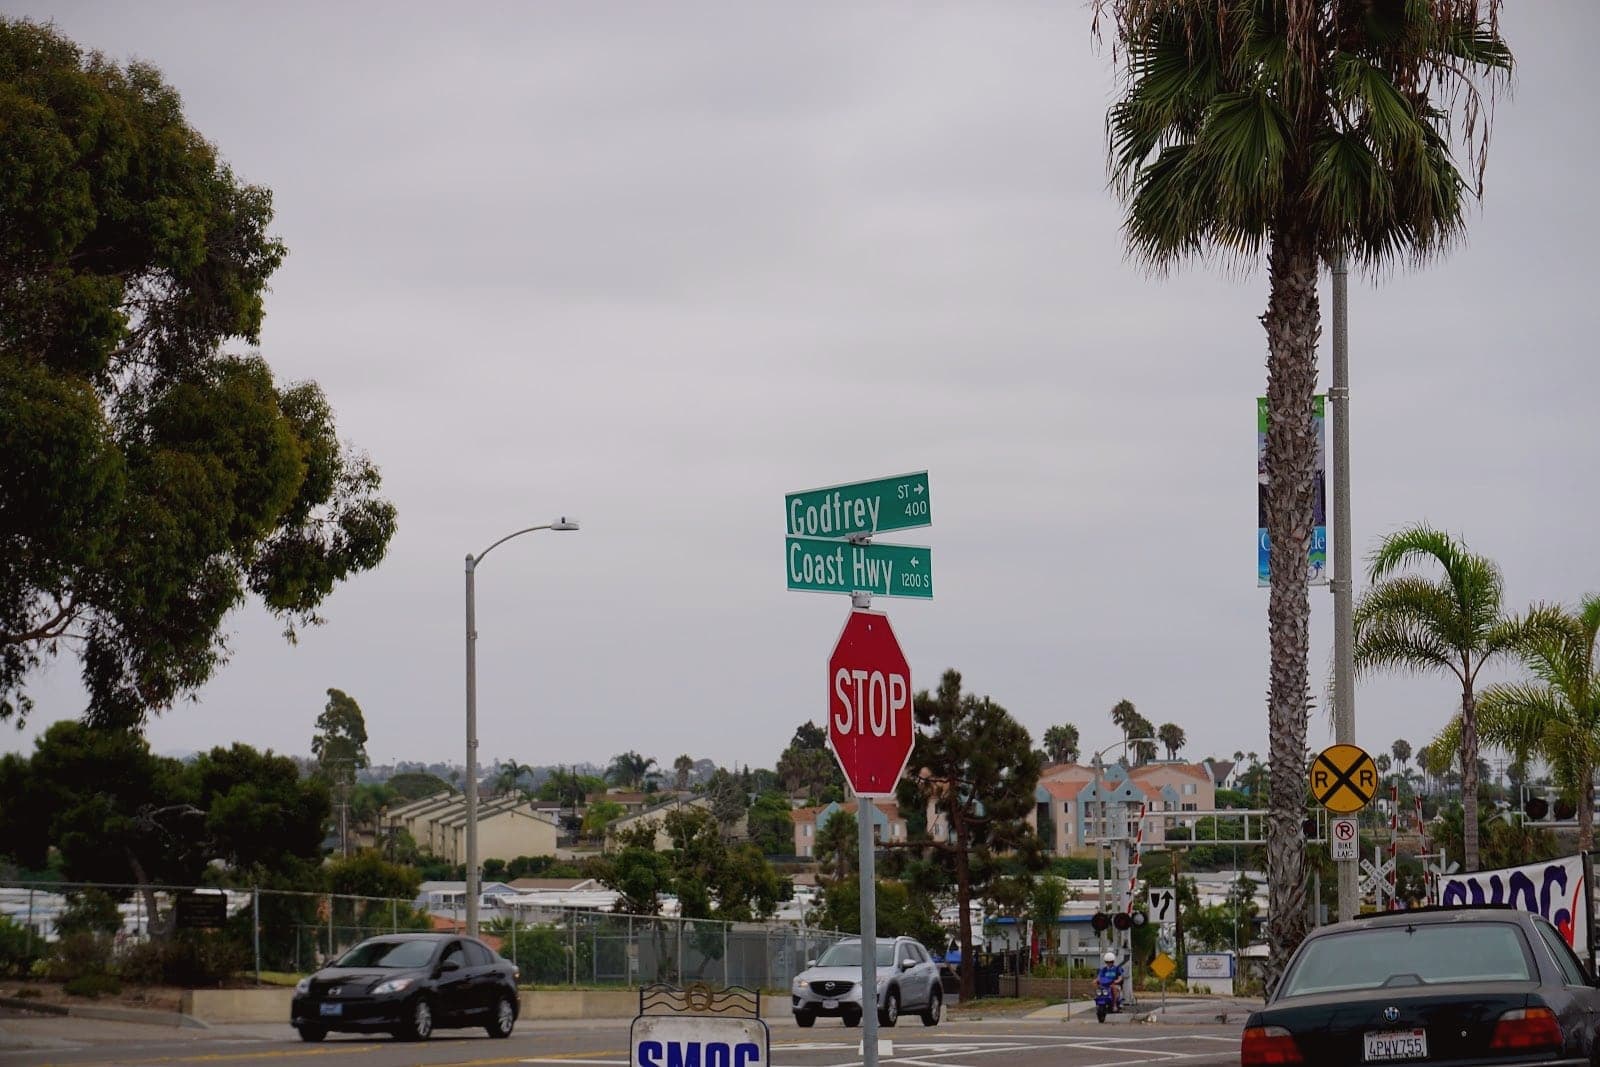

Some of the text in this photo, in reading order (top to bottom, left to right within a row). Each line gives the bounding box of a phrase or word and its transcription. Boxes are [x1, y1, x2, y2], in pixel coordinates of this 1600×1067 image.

[790, 484, 909, 536] Godfrey ST
[905, 501, 927, 516] 400
[790, 543, 929, 595] Coast Hwy 1200 S
[835, 668, 906, 736] STOP
[1315, 770, 1373, 788] R R
[1369, 1039, 1421, 1056] 4PWV755
